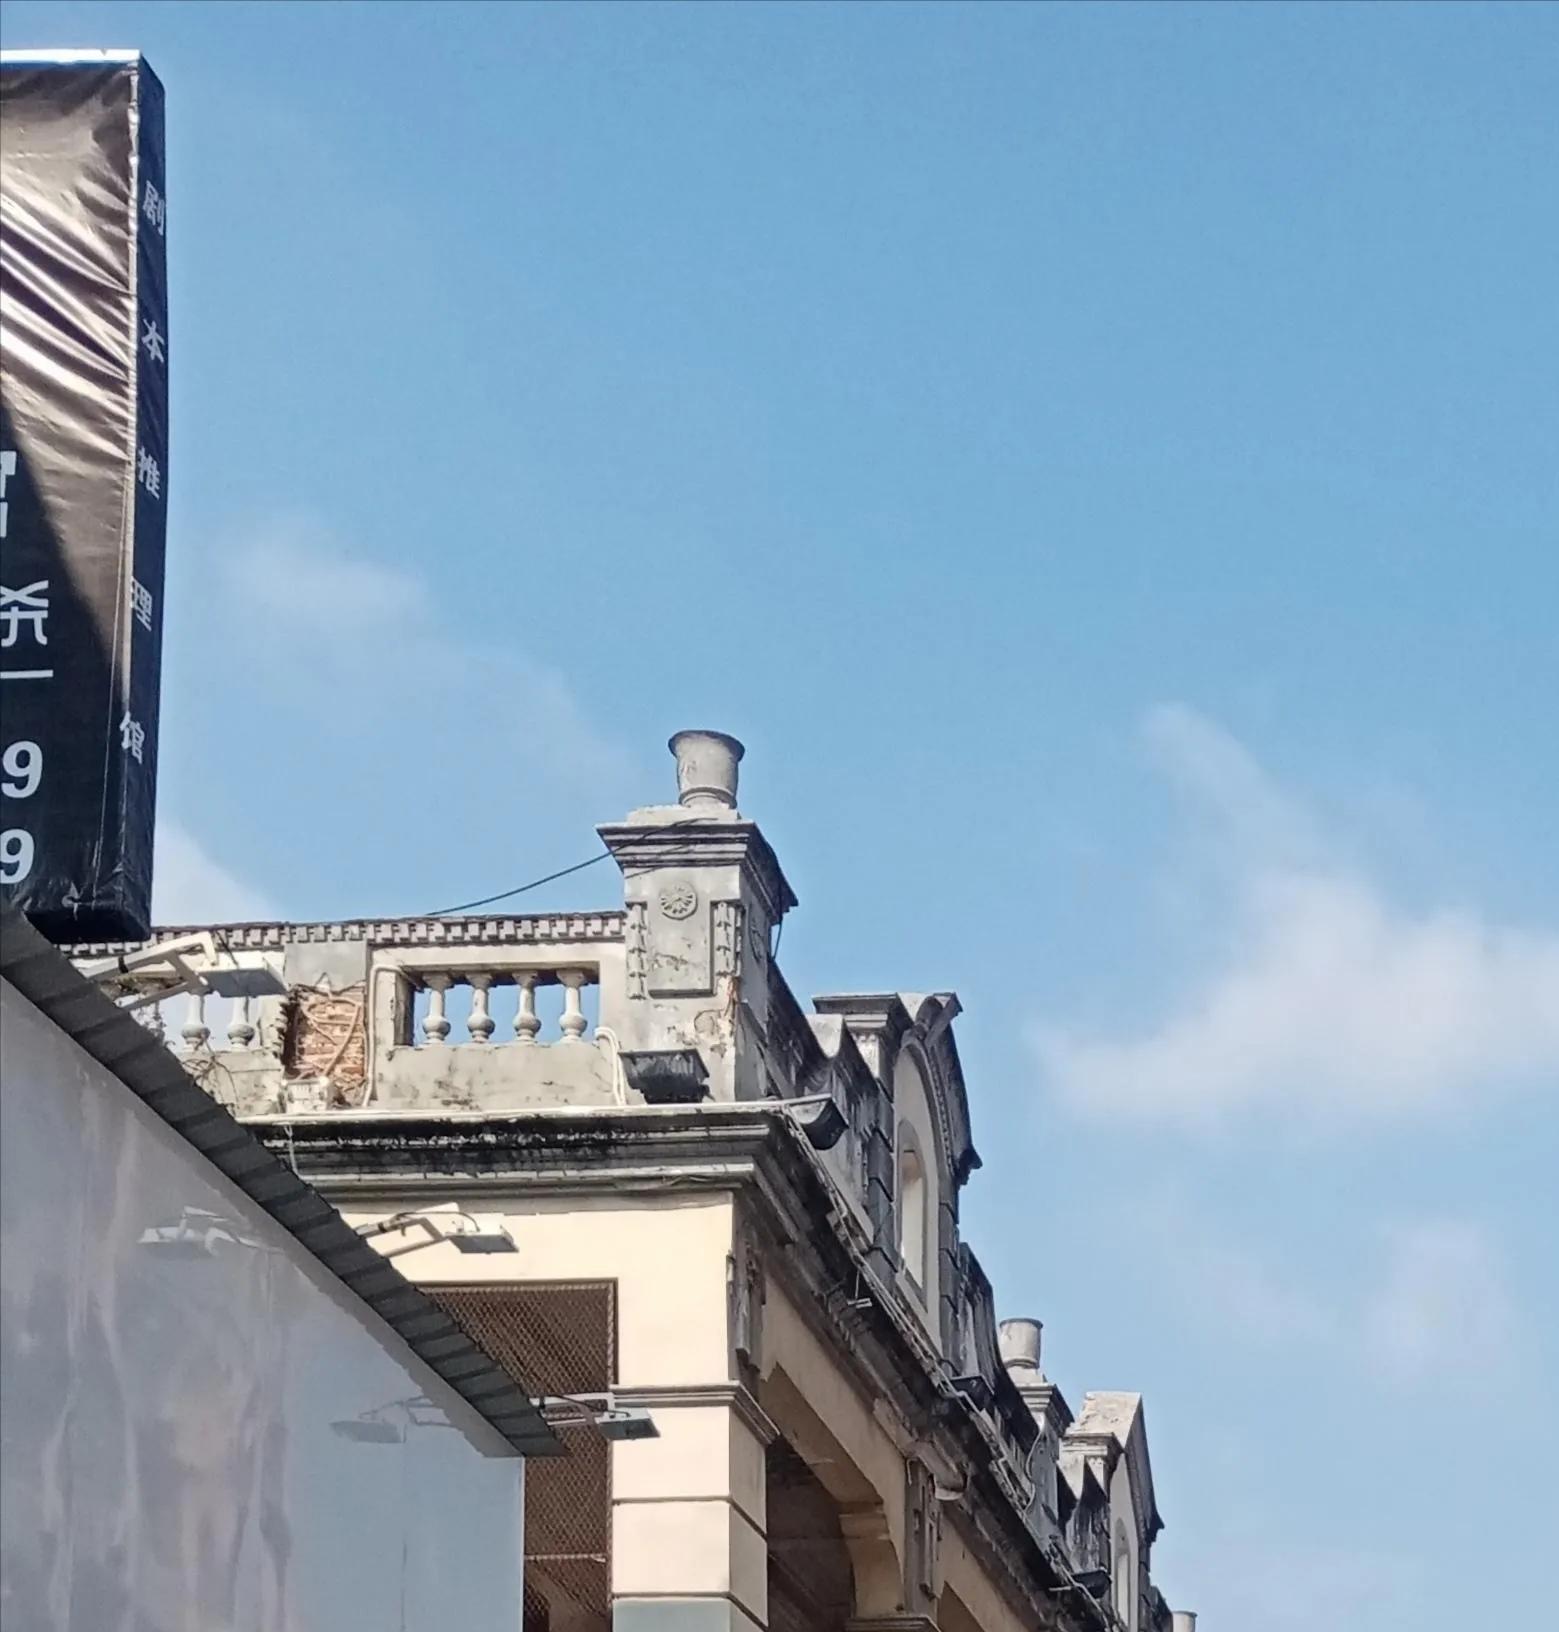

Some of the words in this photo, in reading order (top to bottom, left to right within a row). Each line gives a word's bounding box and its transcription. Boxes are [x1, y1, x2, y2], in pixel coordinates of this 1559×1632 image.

[119, 179, 165, 765] 剧本推理馆
